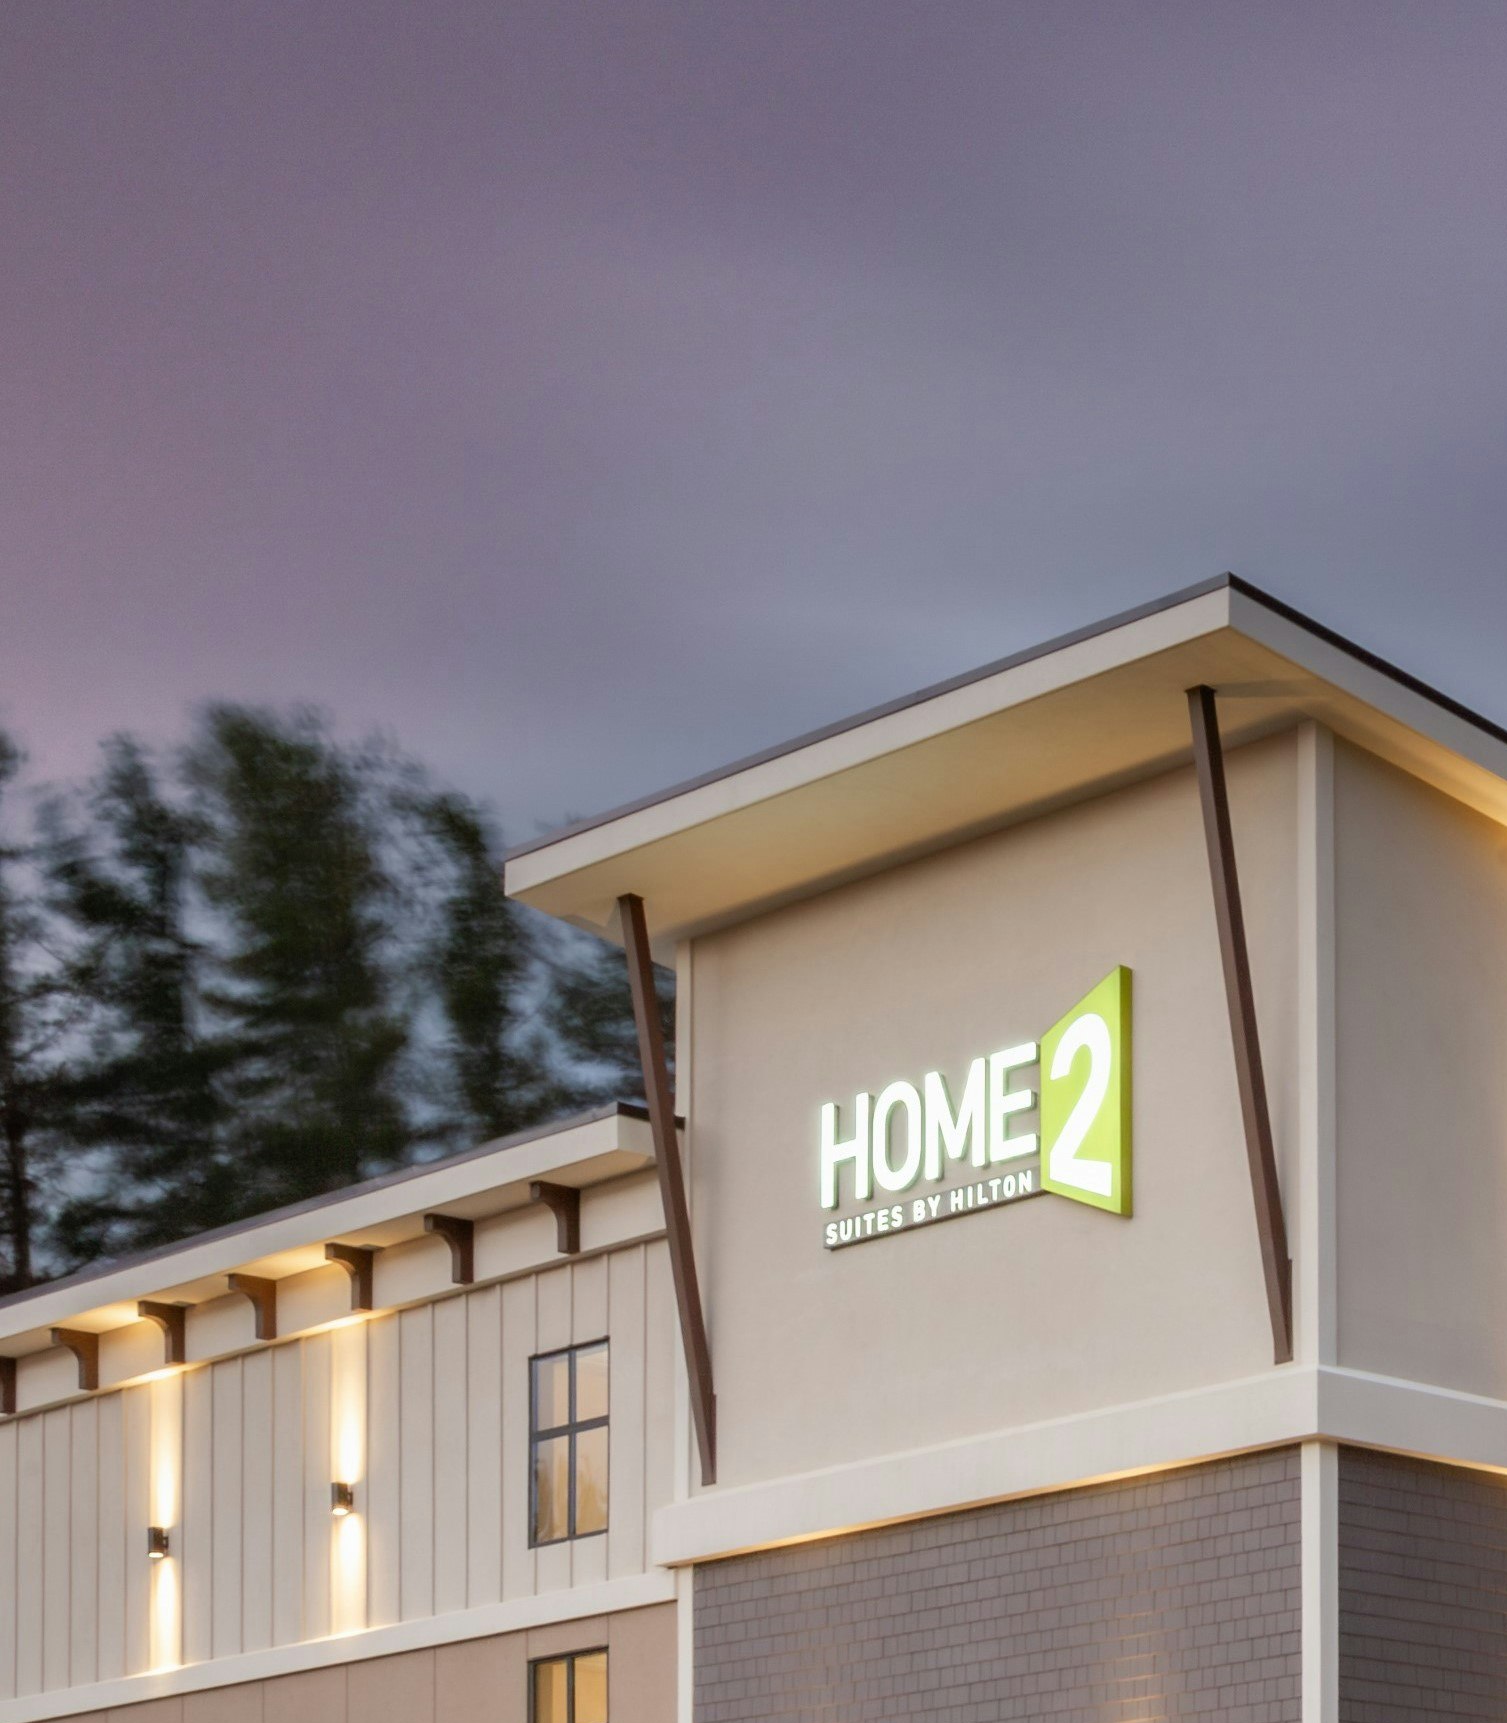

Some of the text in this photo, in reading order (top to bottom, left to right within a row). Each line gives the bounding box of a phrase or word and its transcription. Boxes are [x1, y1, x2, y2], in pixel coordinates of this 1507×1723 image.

[820, 1013, 1112, 1209] HOME 2
[825, 1170, 1033, 1245] SUITES BY HILTON
